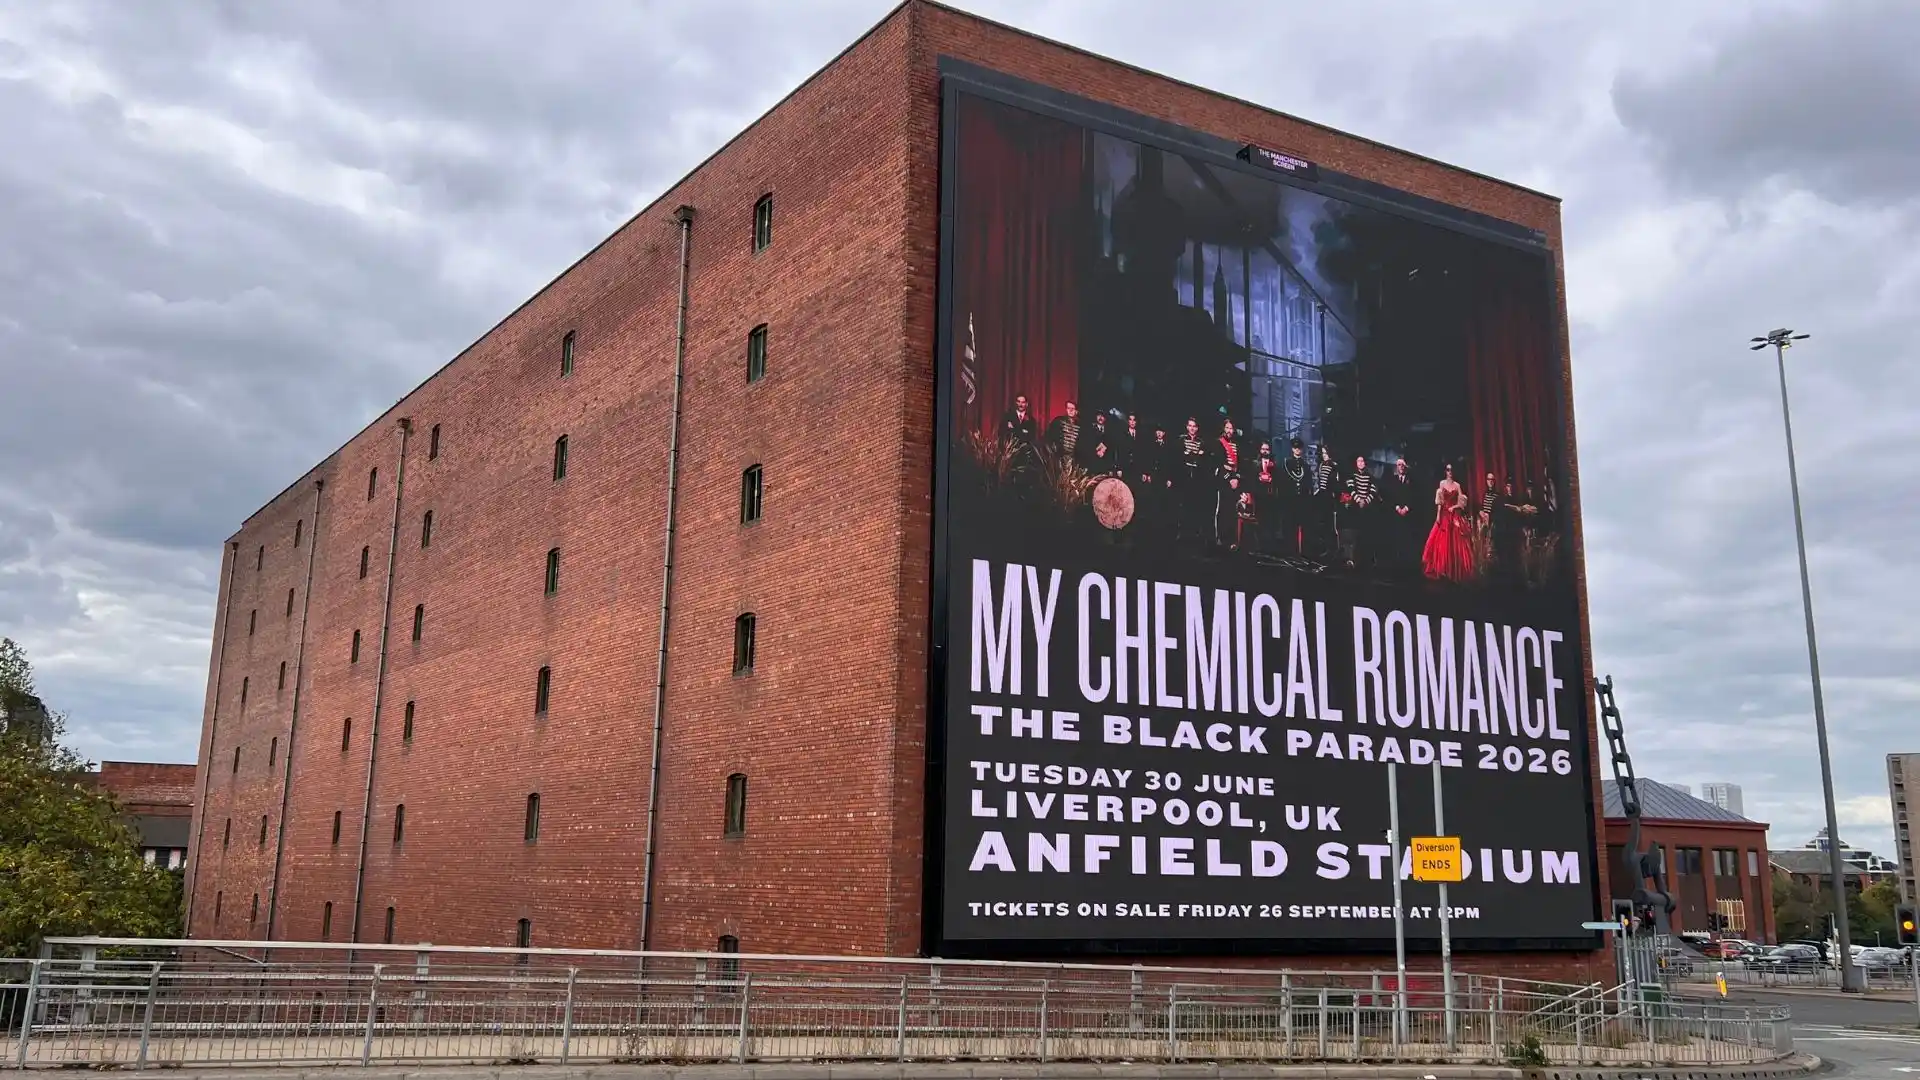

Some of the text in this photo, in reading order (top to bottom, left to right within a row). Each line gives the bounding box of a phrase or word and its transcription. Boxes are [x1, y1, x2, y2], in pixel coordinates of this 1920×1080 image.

[1259, 149, 1308, 169] THE MANCHESTER
[1272, 160, 1296, 171] SCREEN
[970, 558, 1571, 742] MY CHEMICAL ROMANCE
[970, 704, 1573, 776] THE BLACK PARADE 2026
[970, 760, 1276, 797] TUESDAY 30 JUNE
[971, 789, 1342, 834] LIVERPOOL, UK
[968, 830, 1289, 878] ANFIELD
[1416, 843, 1455, 852] Diversion
[1422, 859, 1451, 870] ENDS
[968, 901, 1070, 917] TICKETS
[1077, 902, 1107, 917] ON
[1115, 902, 1171, 917] SALE
[1178, 903, 1253, 918] FRIDAY
[1259, 904, 1283, 918] 26
[1409, 906, 1432, 919] AT
